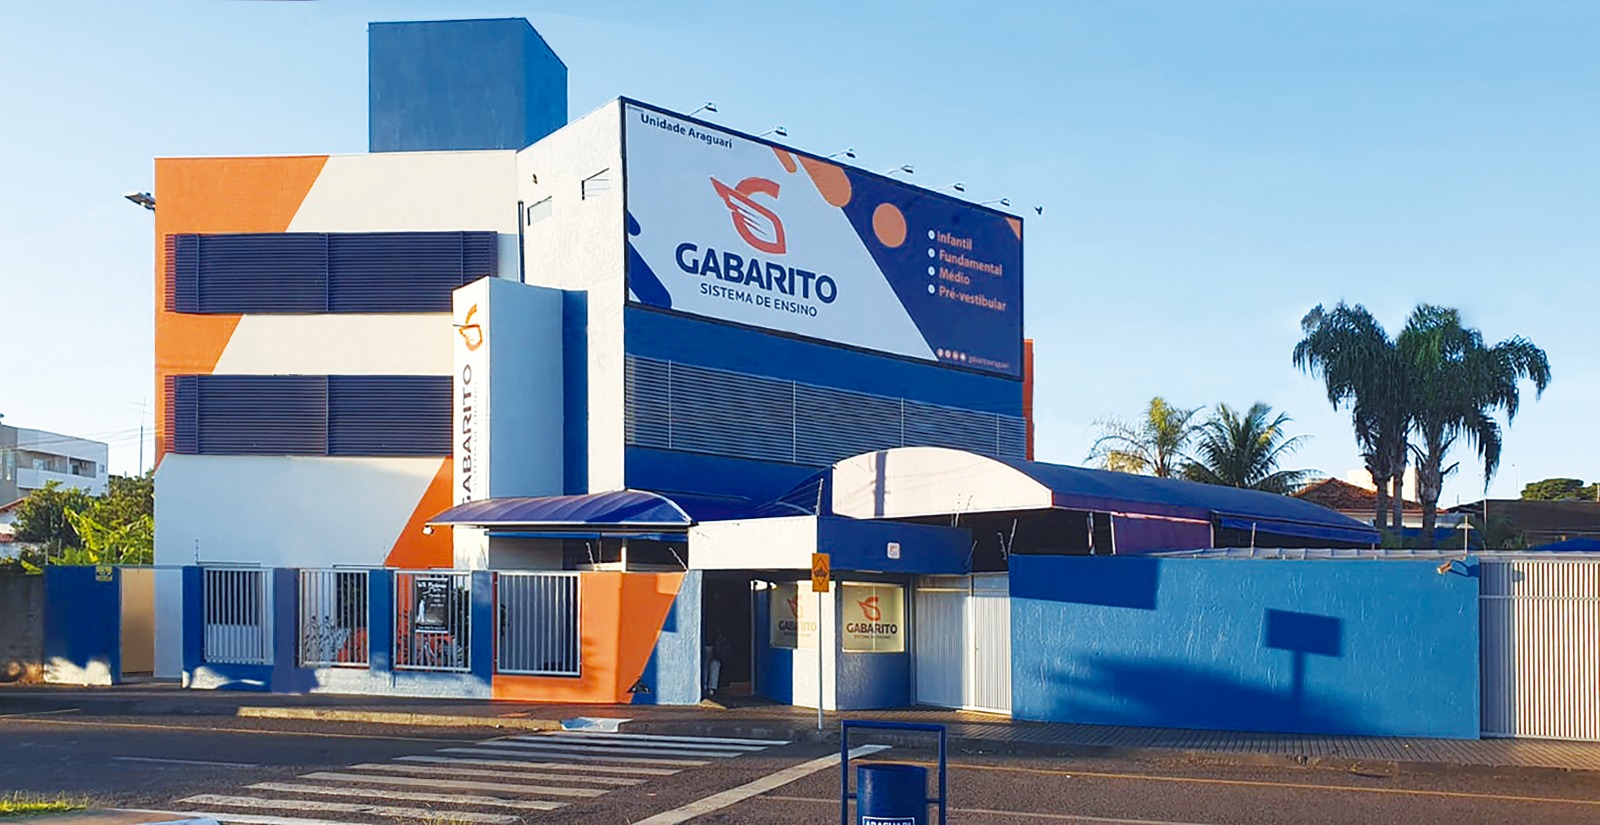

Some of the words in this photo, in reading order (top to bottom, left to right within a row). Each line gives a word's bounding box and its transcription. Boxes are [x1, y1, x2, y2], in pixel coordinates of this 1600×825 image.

[641, 113, 686, 135] Unidade
[688, 128, 732, 149] Araguari
[937, 231, 972, 250] Infantil
[675, 242, 838, 304] GABARITO
[940, 249, 1002, 276] Fundamental
[940, 267, 970, 285] Médio
[700, 283, 753, 304] SISTEMA
[756, 294, 771, 308] DE
[774, 299, 817, 317] ENSINO
[940, 285, 1006, 311] Pré-vestibular
[846, 623, 898, 634] GABARITO
